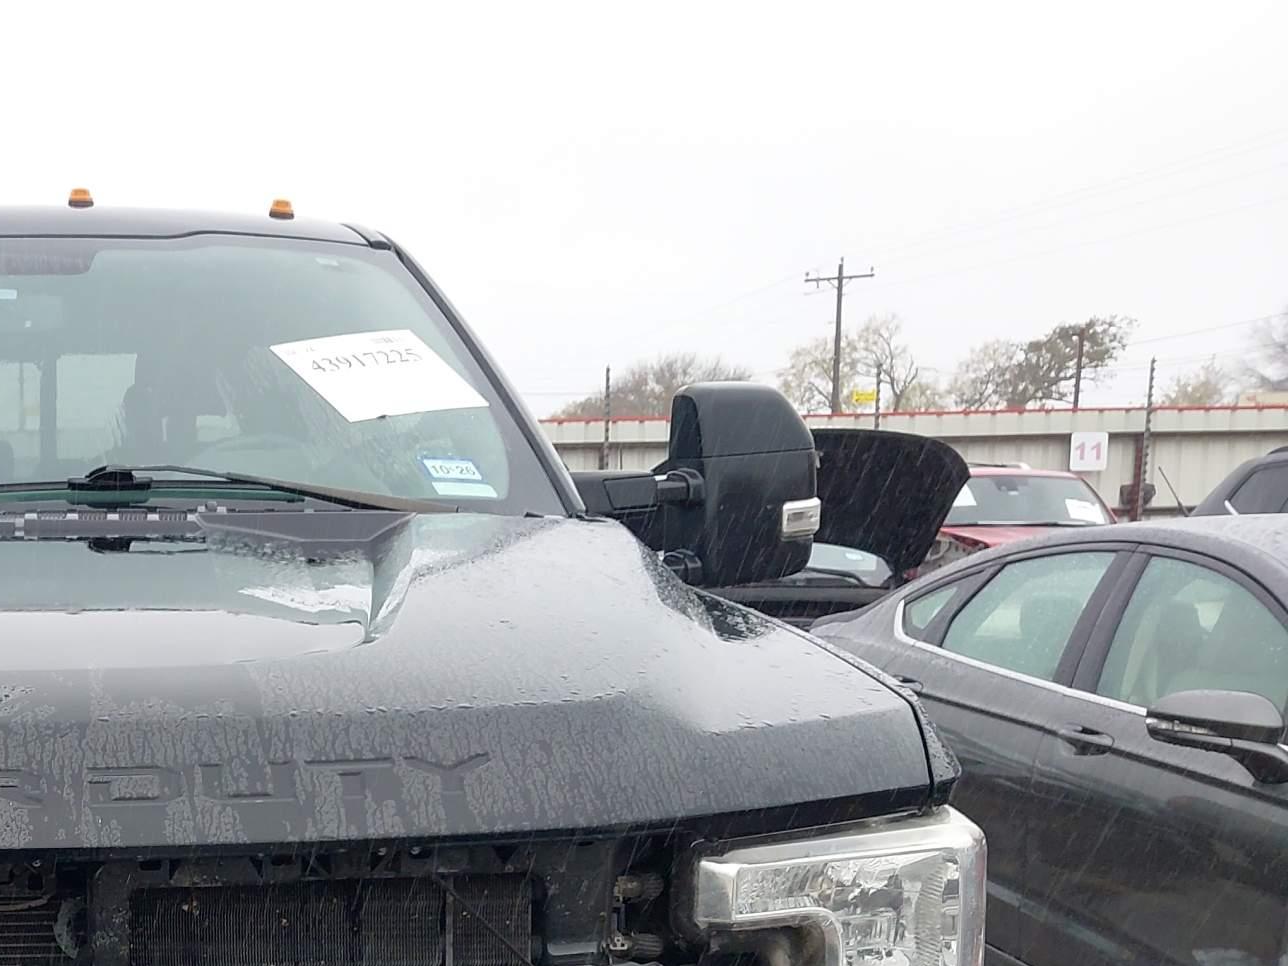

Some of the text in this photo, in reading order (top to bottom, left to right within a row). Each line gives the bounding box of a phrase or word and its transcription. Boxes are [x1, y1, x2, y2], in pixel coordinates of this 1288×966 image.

[311, 347, 424, 373] 43917225
[1075, 441, 1102, 461] 11
[86, 752, 492, 807] DUTY
